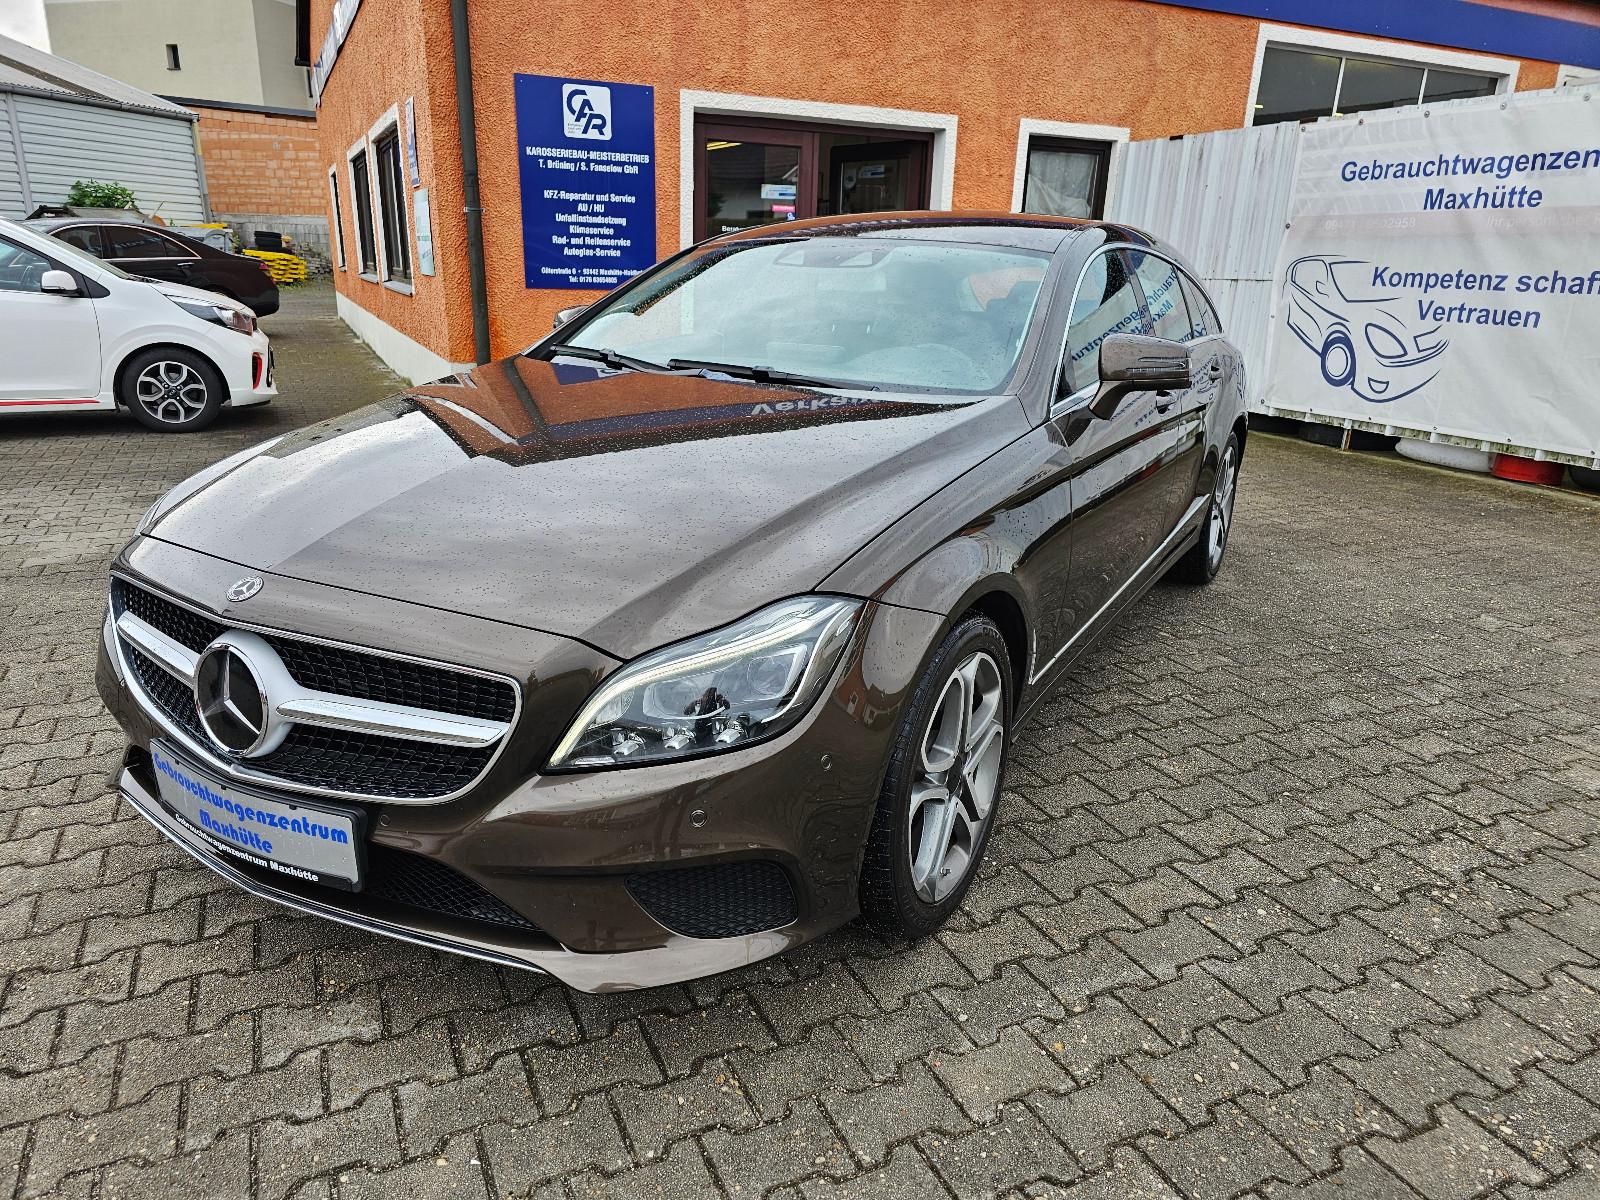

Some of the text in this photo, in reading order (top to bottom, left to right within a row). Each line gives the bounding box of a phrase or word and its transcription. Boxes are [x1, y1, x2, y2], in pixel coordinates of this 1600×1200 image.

[566, 88, 606, 136] CAR
[526, 146, 650, 164] KAROSSERIEBAU-MEISTERBETRIEB
[538, 159, 546, 169] T.
[547, 160, 575, 172] Brüning
[581, 162, 589, 171] S.
[590, 163, 622, 173] Fanselow
[624, 165, 639, 174] GbR
[543, 190, 636, 203] KFZ-Reparatur und Service
[1423, 185, 1543, 210] Maxhütte
[594, 204, 605, 213] HU
[555, 213, 627, 226] Unfallinstandsetzung
[569, 225, 614, 235] Klimaservice
[552, 236, 631, 247] Rad- und Reifenservice
[563, 247, 621, 257] Autoglas-Service
[1371, 266, 1600, 295] Kompetenz schaf
[1417, 299, 1542, 329] Vertrauen
[153, 752, 348, 844] Gebrauchtwagenzentrum
[199, 808, 274, 854] Maxhütte
[175, 813, 319, 882] Gebrauchtwagenzentrum Maxhütte
